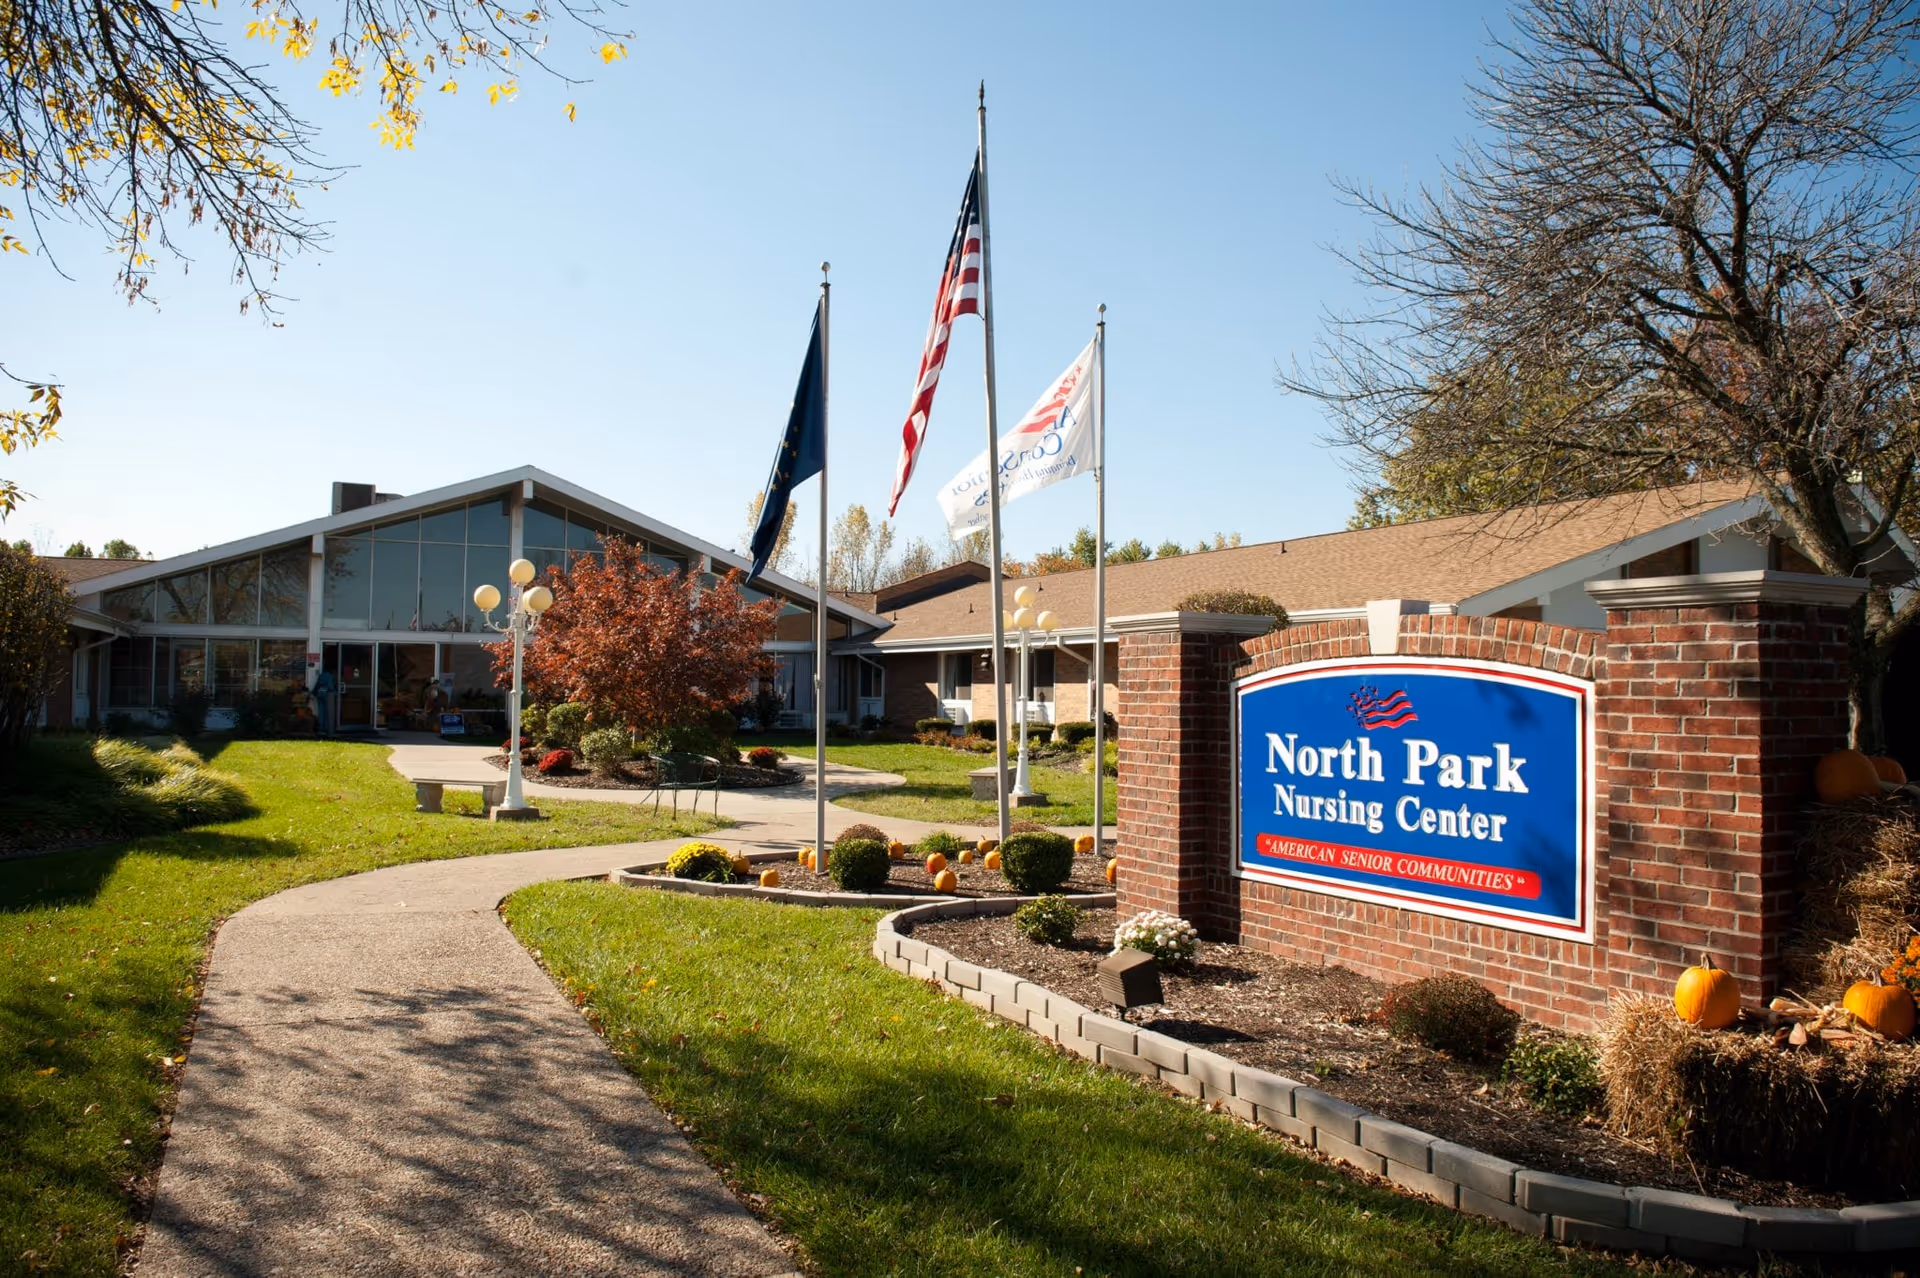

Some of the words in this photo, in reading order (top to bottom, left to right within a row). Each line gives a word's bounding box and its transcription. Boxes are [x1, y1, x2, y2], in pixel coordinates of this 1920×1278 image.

[1265, 732, 1385, 782] North
[1402, 738, 1529, 793] Park
[1273, 783, 1384, 834] Nursing
[1395, 795, 1508, 842] Center
[1341, 850, 1393, 872] SENIOR
